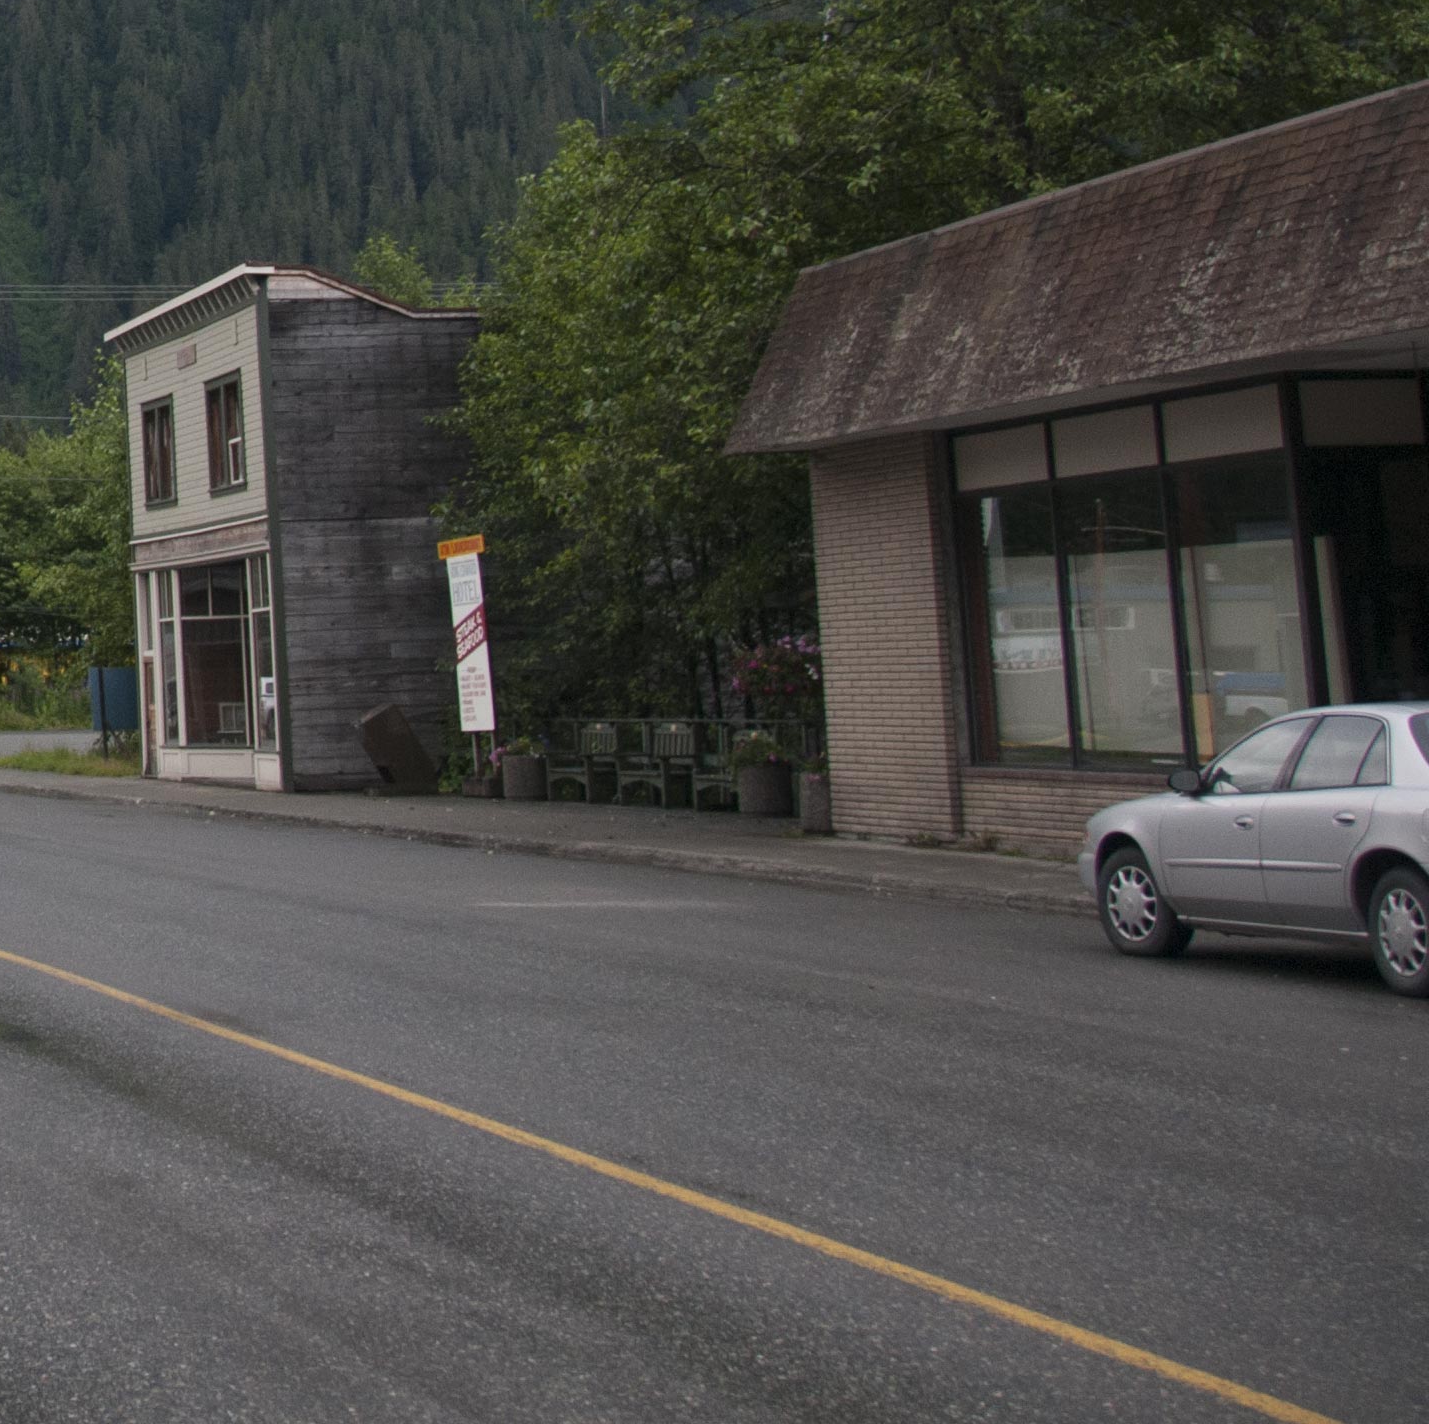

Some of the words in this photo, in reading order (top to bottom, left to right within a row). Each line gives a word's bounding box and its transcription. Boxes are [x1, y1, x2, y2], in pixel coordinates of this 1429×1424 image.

[452, 579, 481, 604] HOTEL
[455, 615, 477, 644] STEAK
[456, 625, 484, 660] SEAFOOD
